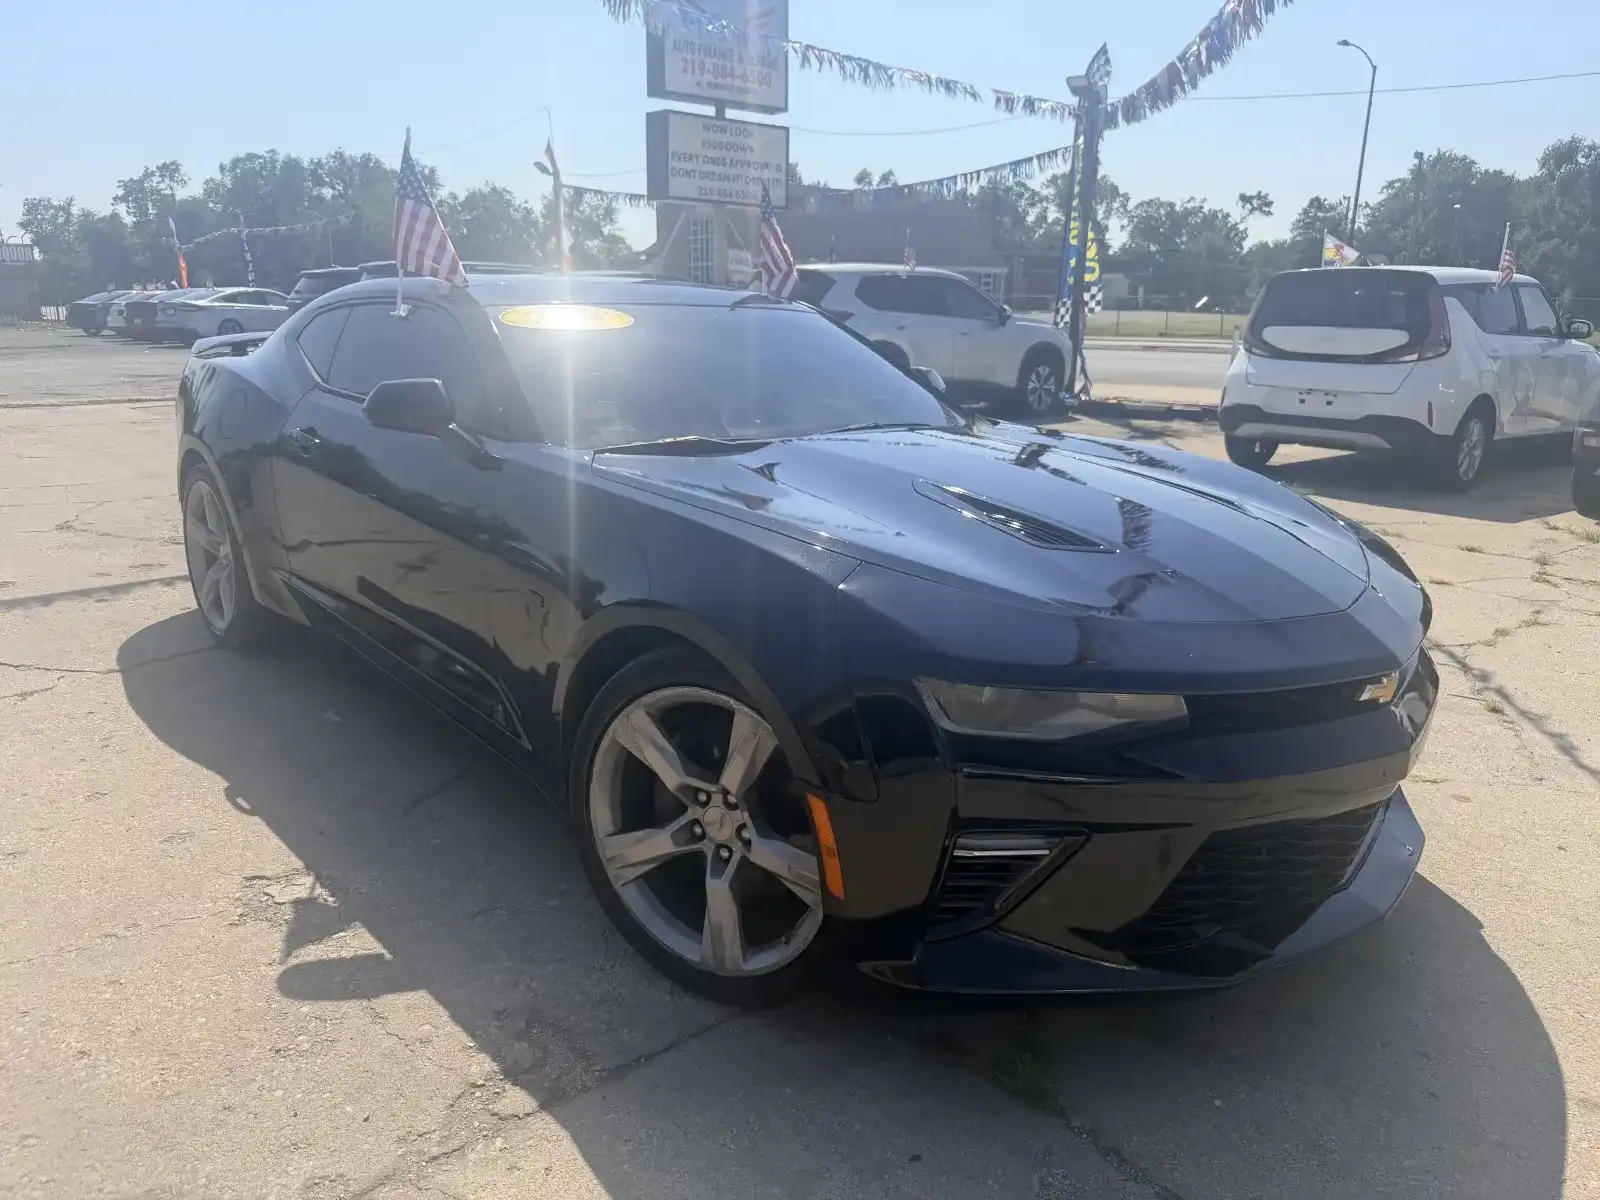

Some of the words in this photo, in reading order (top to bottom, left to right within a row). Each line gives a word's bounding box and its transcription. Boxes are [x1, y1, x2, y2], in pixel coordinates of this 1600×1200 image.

[673, 38, 695, 55] AUTO
[702, 123, 728, 135] WOW
[725, 141, 755, 154] DOWN
[671, 150, 700, 165] EVERY
[703, 154, 727, 168] ONES
[699, 170, 731, 183] DREAM
